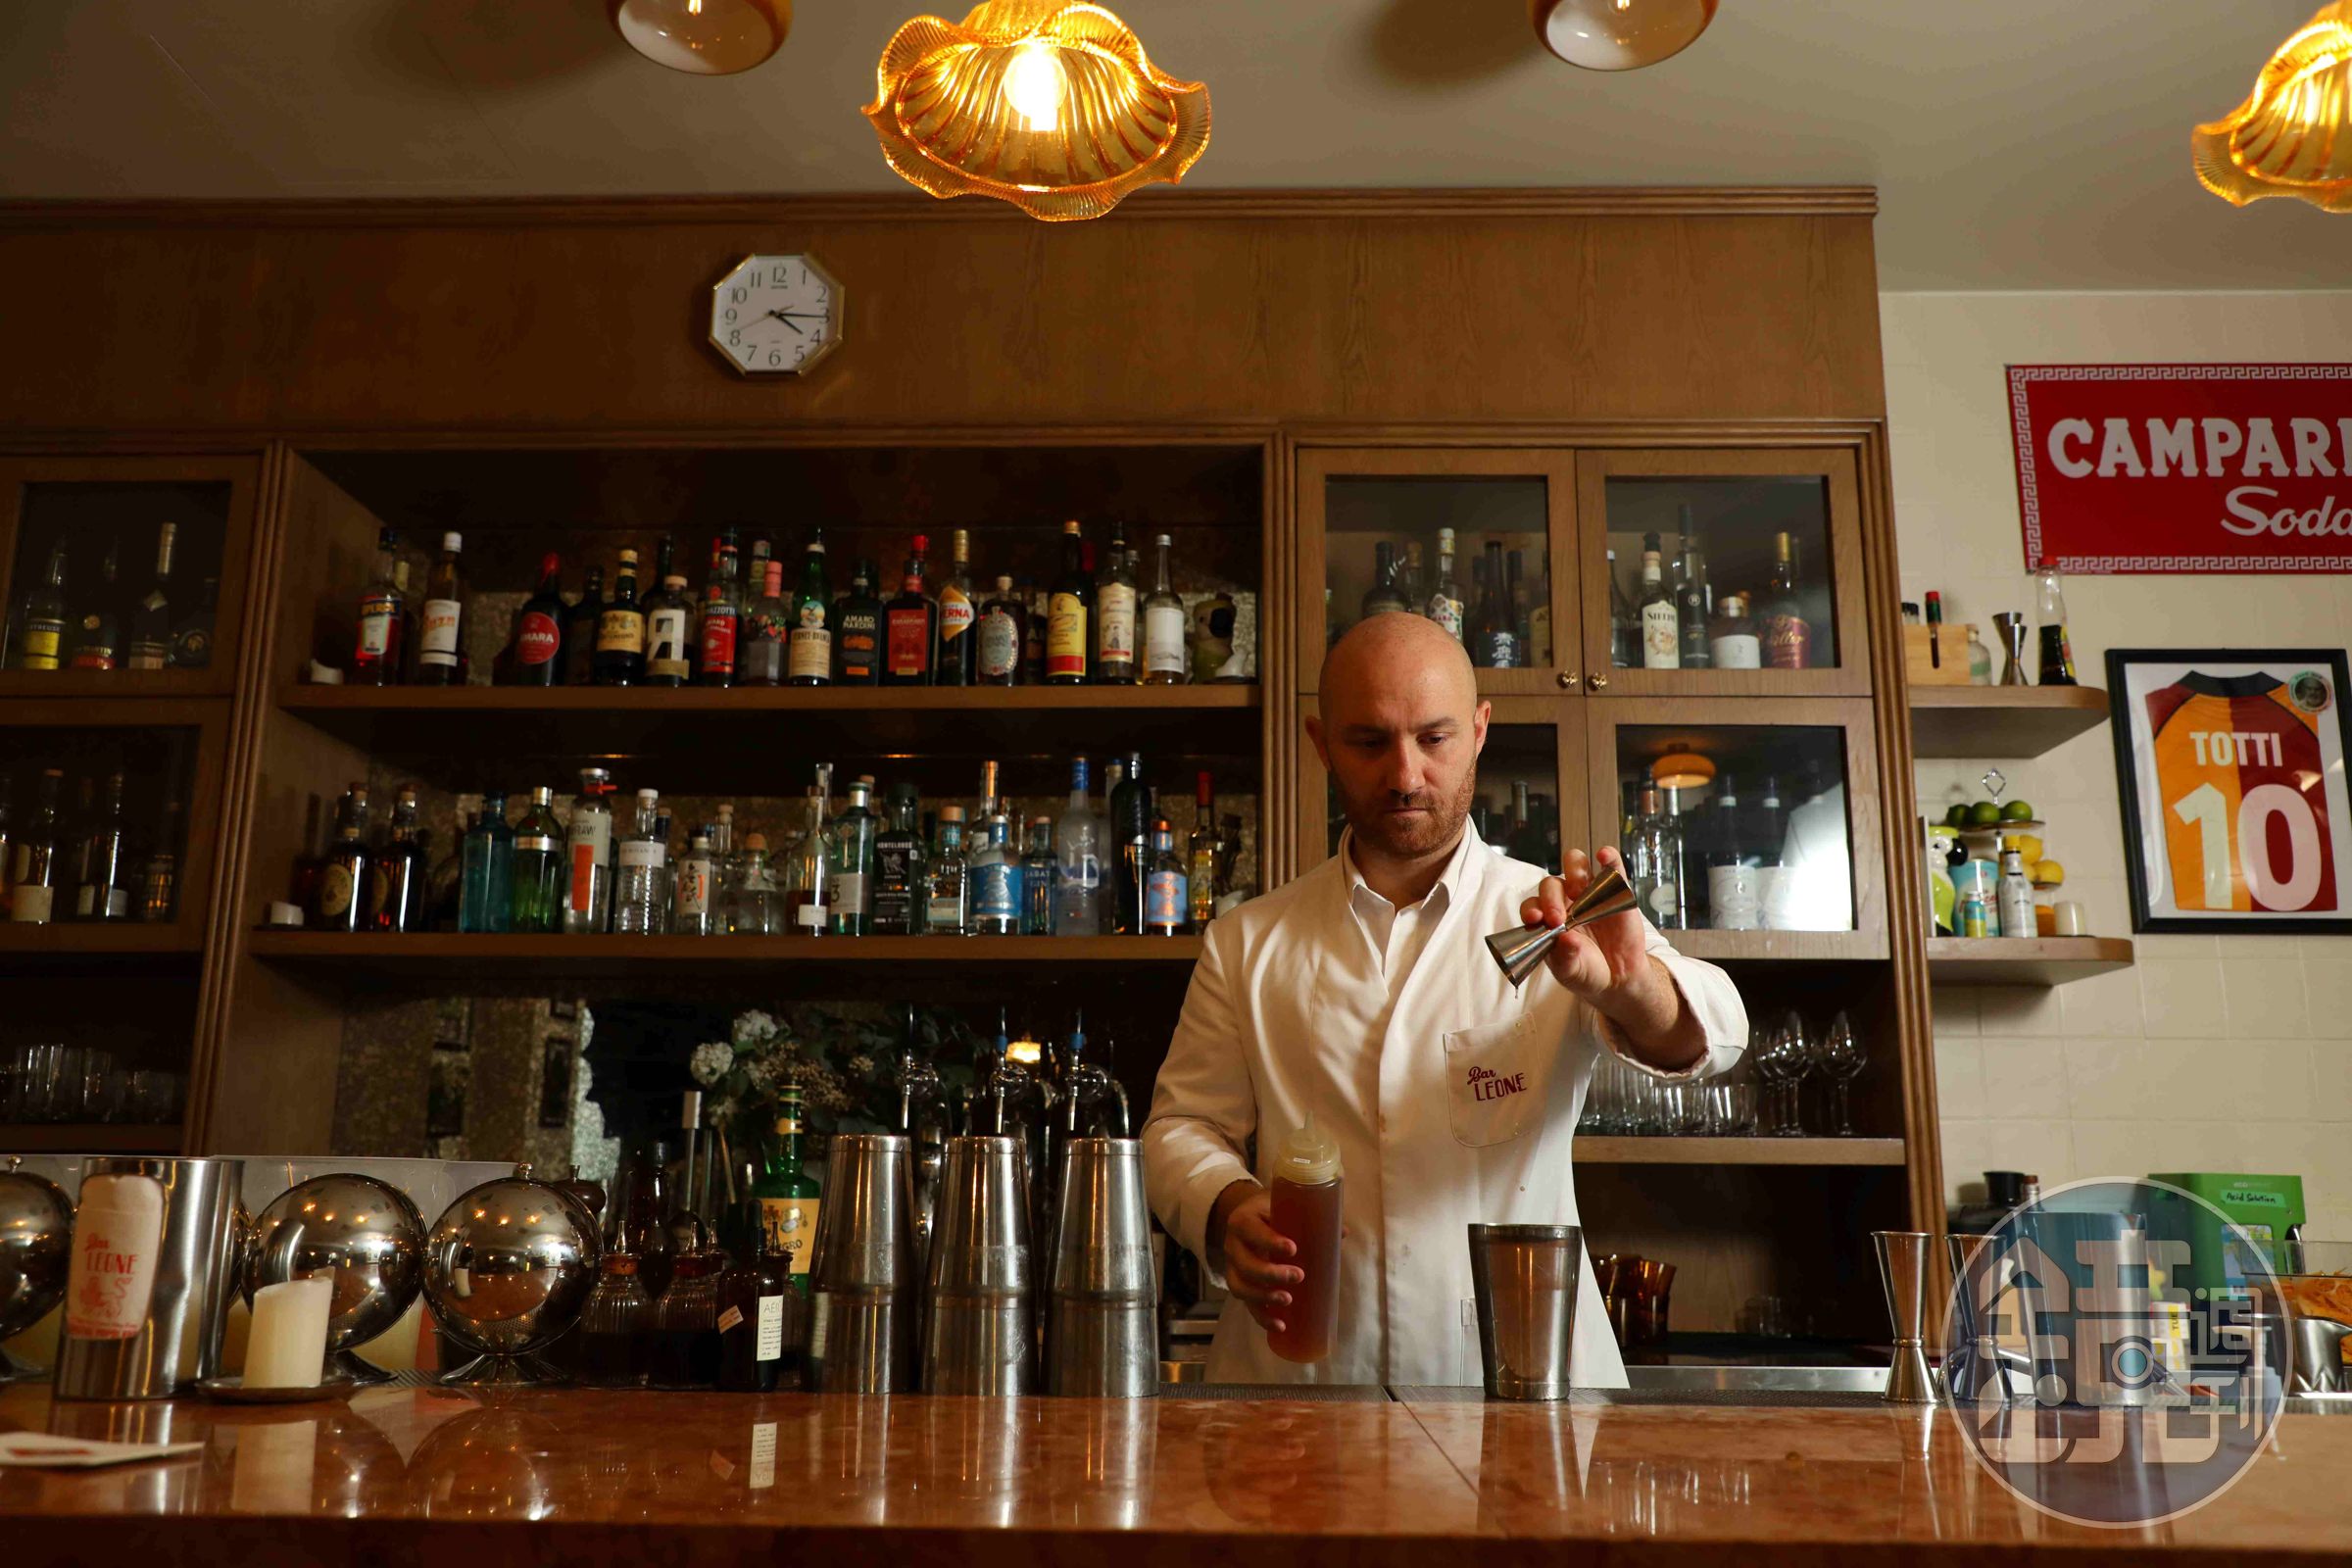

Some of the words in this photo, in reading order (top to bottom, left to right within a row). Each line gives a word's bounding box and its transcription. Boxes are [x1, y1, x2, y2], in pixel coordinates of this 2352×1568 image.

[750, 271, 761, 288] 11
[772, 267, 787, 283] 12
[731, 287, 748, 304] 10
[816, 286, 827, 303] 2
[725, 309, 738, 325] 9
[730, 329, 741, 347] 8
[810, 329, 821, 346] 4
[747, 345, 758, 362] 7
[768, 349, 781, 367] 6
[795, 346, 806, 363] 5
[2047, 416, 2352, 478] CAMPARI
[2220, 485, 2352, 537] Soda
[844, 613, 875, 623] AMARO
[2189, 731, 2283, 767] TOTTI
[2173, 782, 2323, 912] 10
[1466, 1065, 1496, 1085] Bar
[1474, 1072, 1527, 1102] LEONE
[2227, 1193, 2244, 1202] Acid
[2246, 1193, 2276, 1203] Solution
